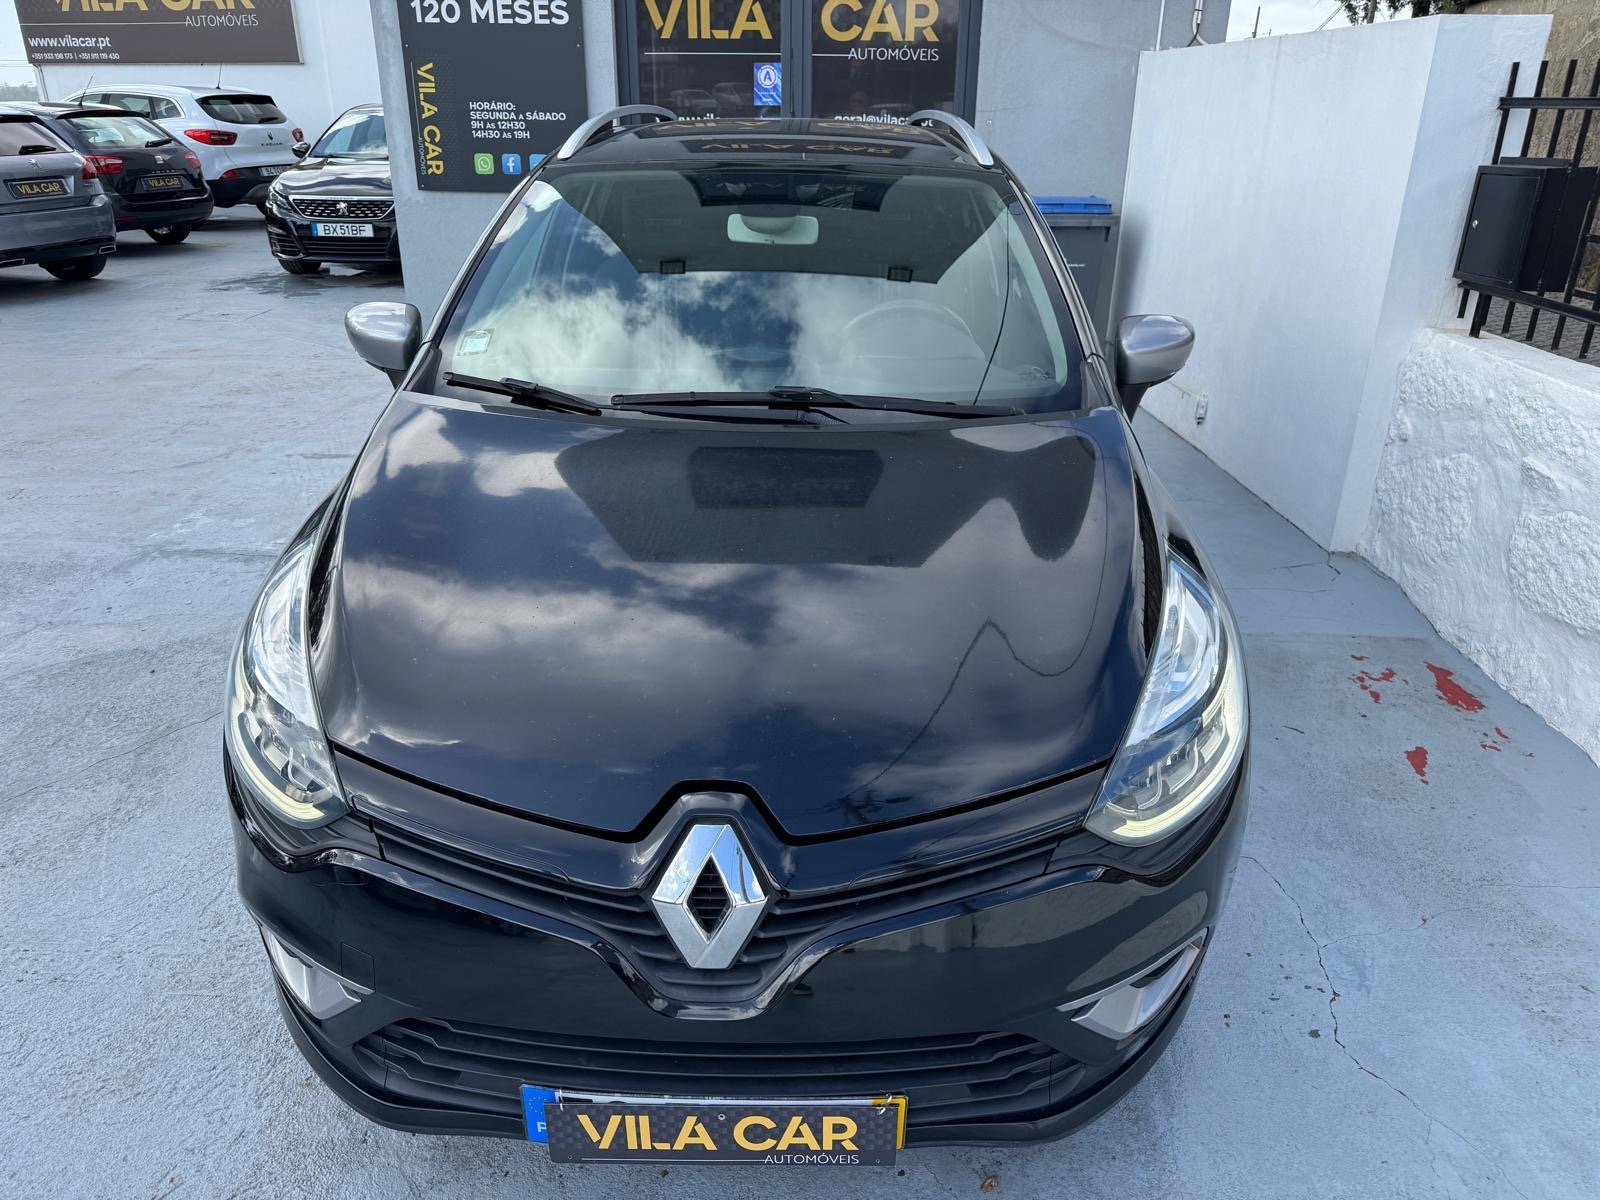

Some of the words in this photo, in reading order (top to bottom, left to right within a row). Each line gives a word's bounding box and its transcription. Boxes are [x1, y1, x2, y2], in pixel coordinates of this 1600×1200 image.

[185, 12, 259, 27] AUTOMÓVEIS
[411, 0, 461, 24] 120
[471, 0, 570, 25] MESES
[646, 0, 773, 40] VILA
[821, 0, 940, 42] CAR
[28, 34, 111, 50] www.vilacar.pt
[848, 45, 939, 61] AUTOMÓVEIS
[417, 63, 438, 119] VILA
[469, 101, 516, 111] HORÁRIO:
[470, 111, 517, 120] SEGUNDA
[526, 110, 567, 121] SÁBADO
[470, 120, 484, 129] 9H
[497, 121, 526, 130] 12H30
[472, 130, 500, 139] 14H30
[514, 130, 530, 139] 19H
[424, 125, 445, 175] CAR
[17, 184, 41, 195] VILA
[41, 182, 61, 193] CAR
[576, 1114, 718, 1151] VILA
[733, 1115, 860, 1152] CAR
[764, 1152, 860, 1164] AUTOMÓVEIS
